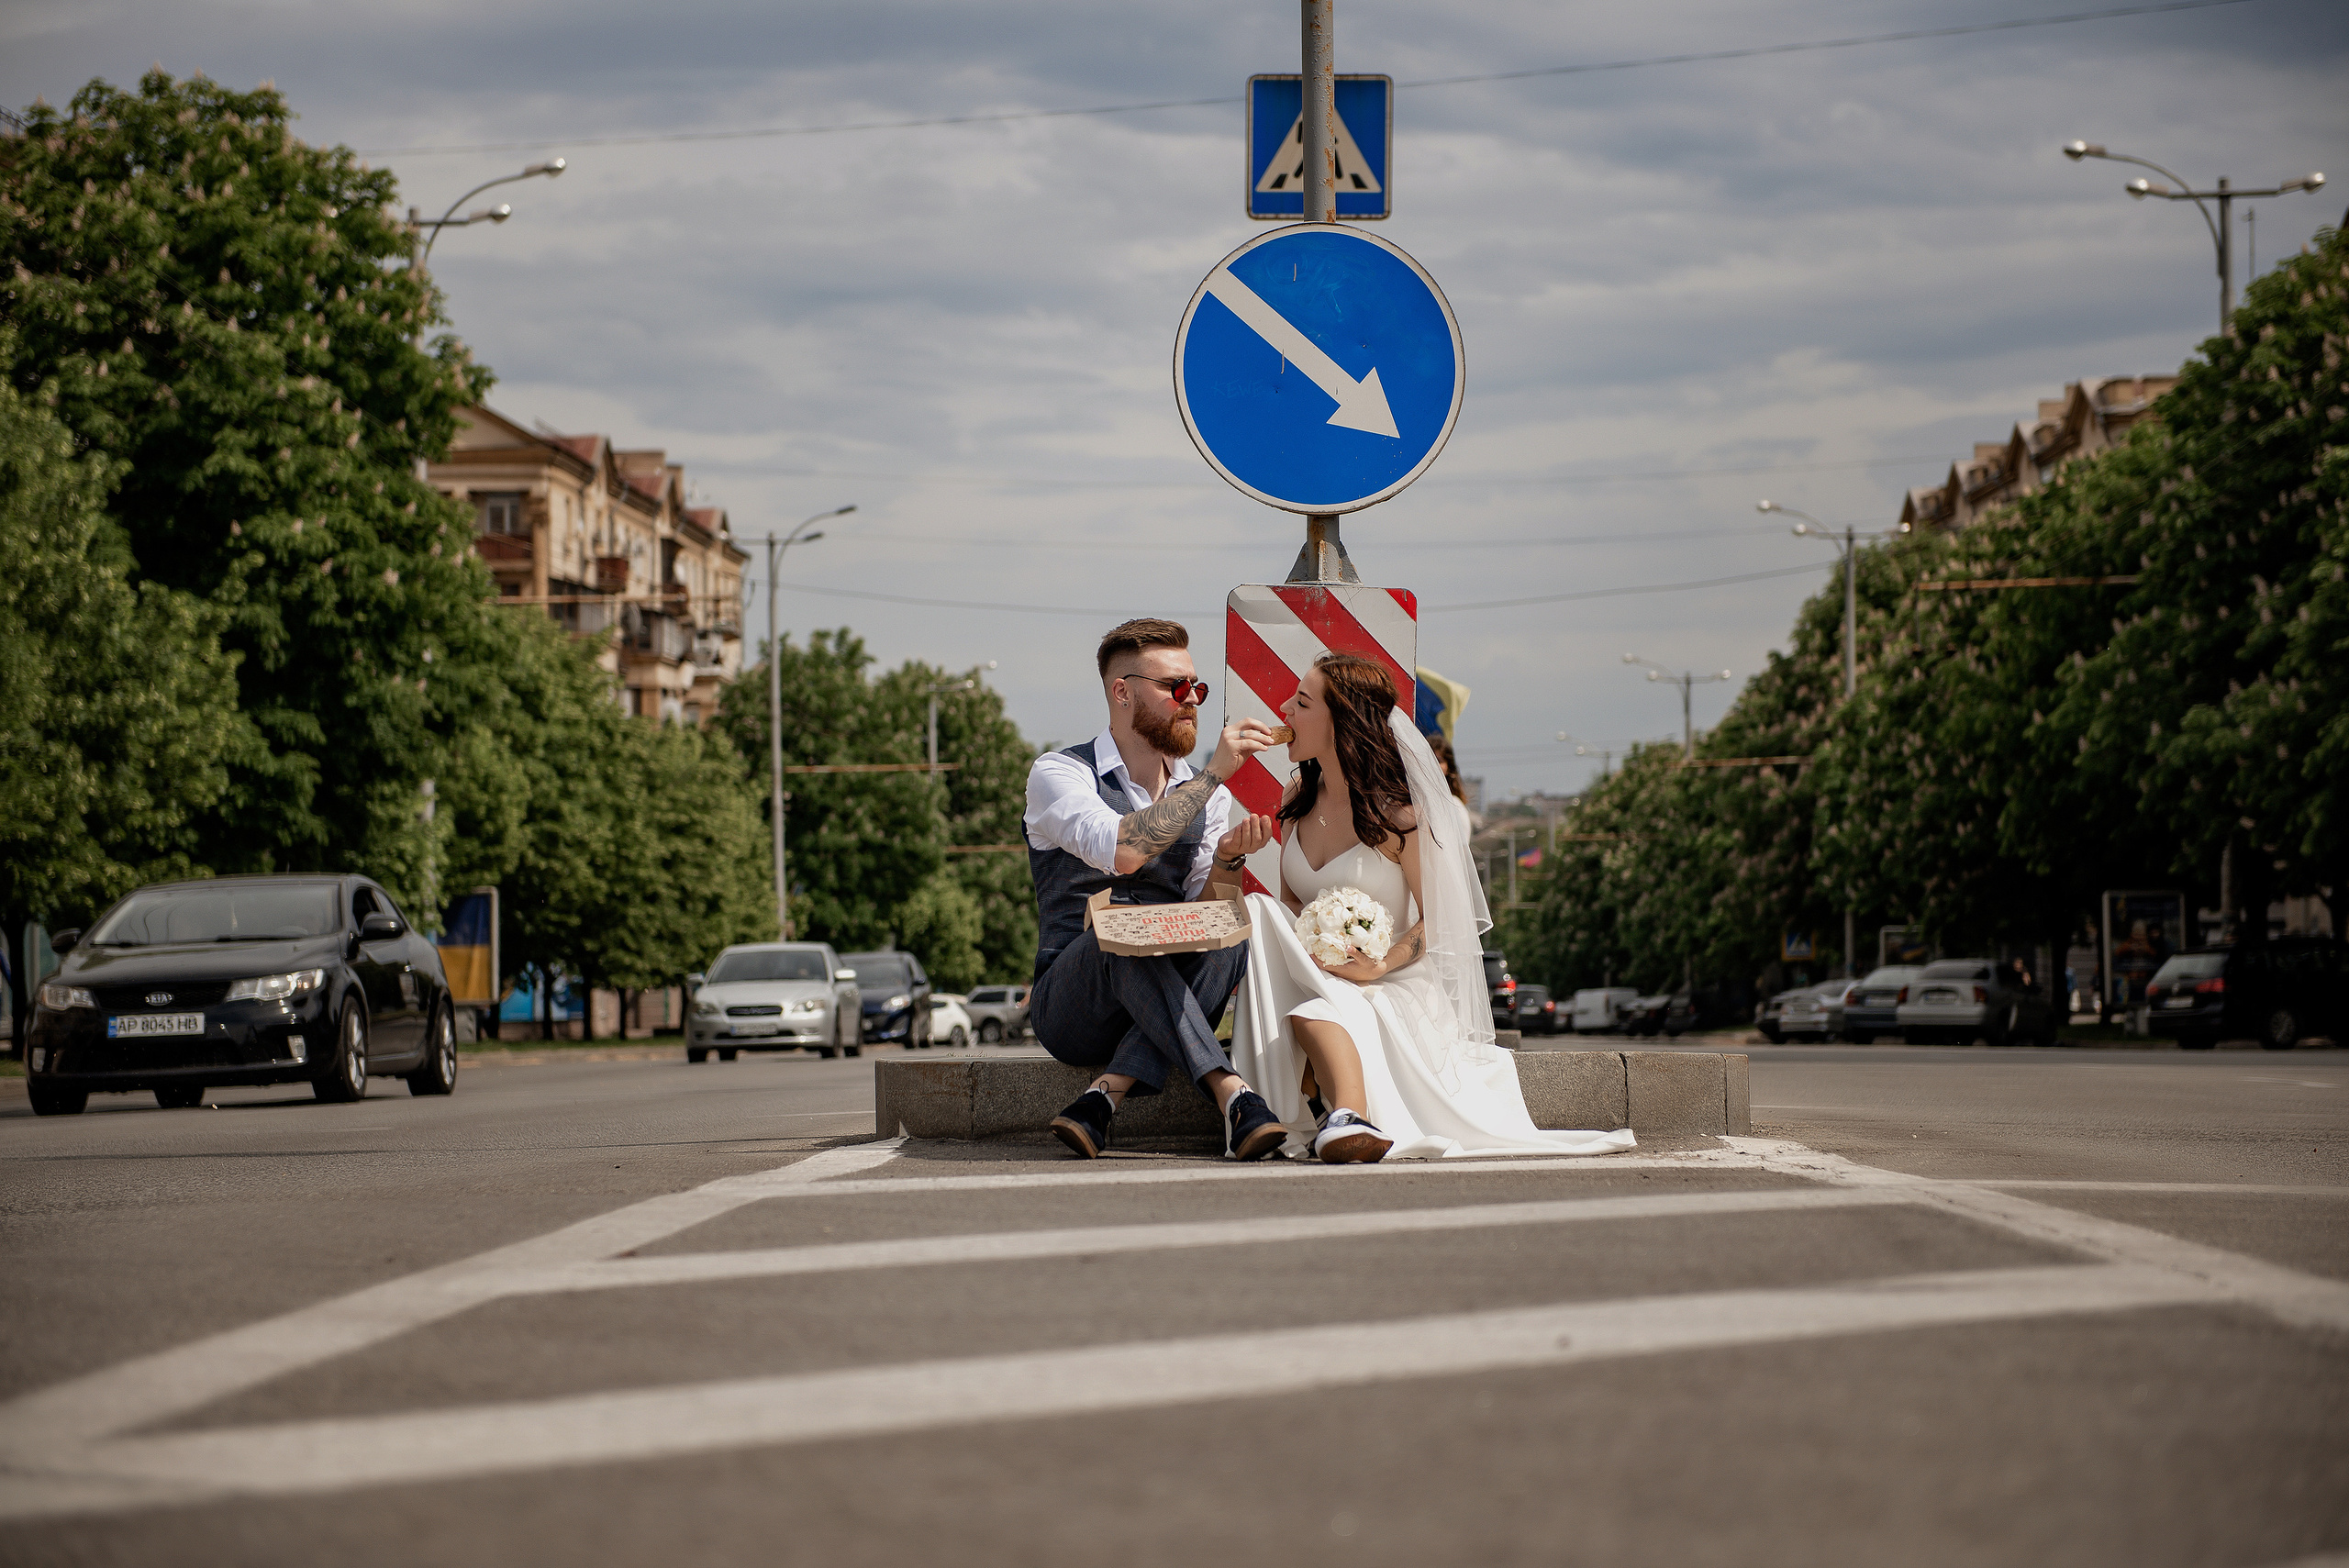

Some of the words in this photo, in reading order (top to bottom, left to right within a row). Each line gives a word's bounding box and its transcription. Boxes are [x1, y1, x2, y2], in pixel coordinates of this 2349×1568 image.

[1141, 914, 1200, 924] WORLD
[1152, 929, 1206, 939] RULES
[117, 1018, 138, 1034] AP
[178, 1014, 198, 1032] HB
